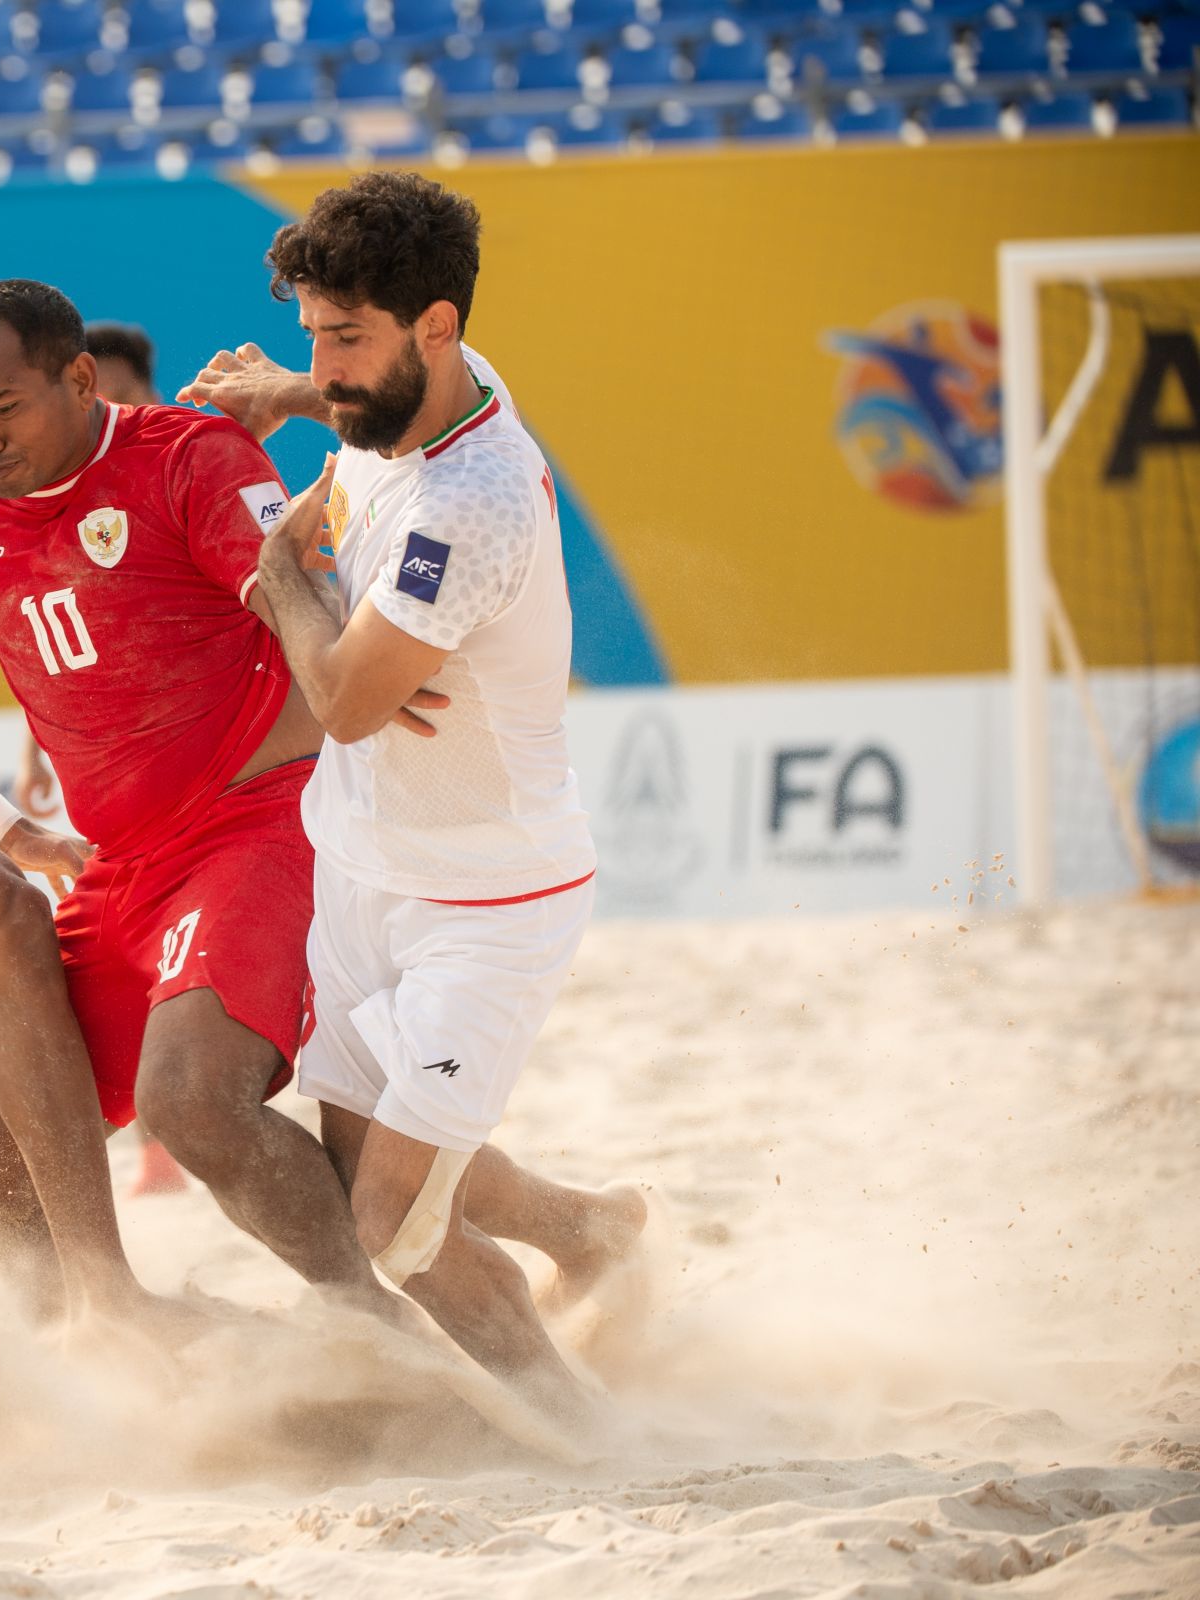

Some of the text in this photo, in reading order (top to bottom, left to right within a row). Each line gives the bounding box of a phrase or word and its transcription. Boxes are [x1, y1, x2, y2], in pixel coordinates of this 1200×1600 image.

[403, 557, 441, 579] AFC
[20, 587, 98, 676] 10
[767, 744, 906, 835] FA
[156, 908, 203, 985] 10
